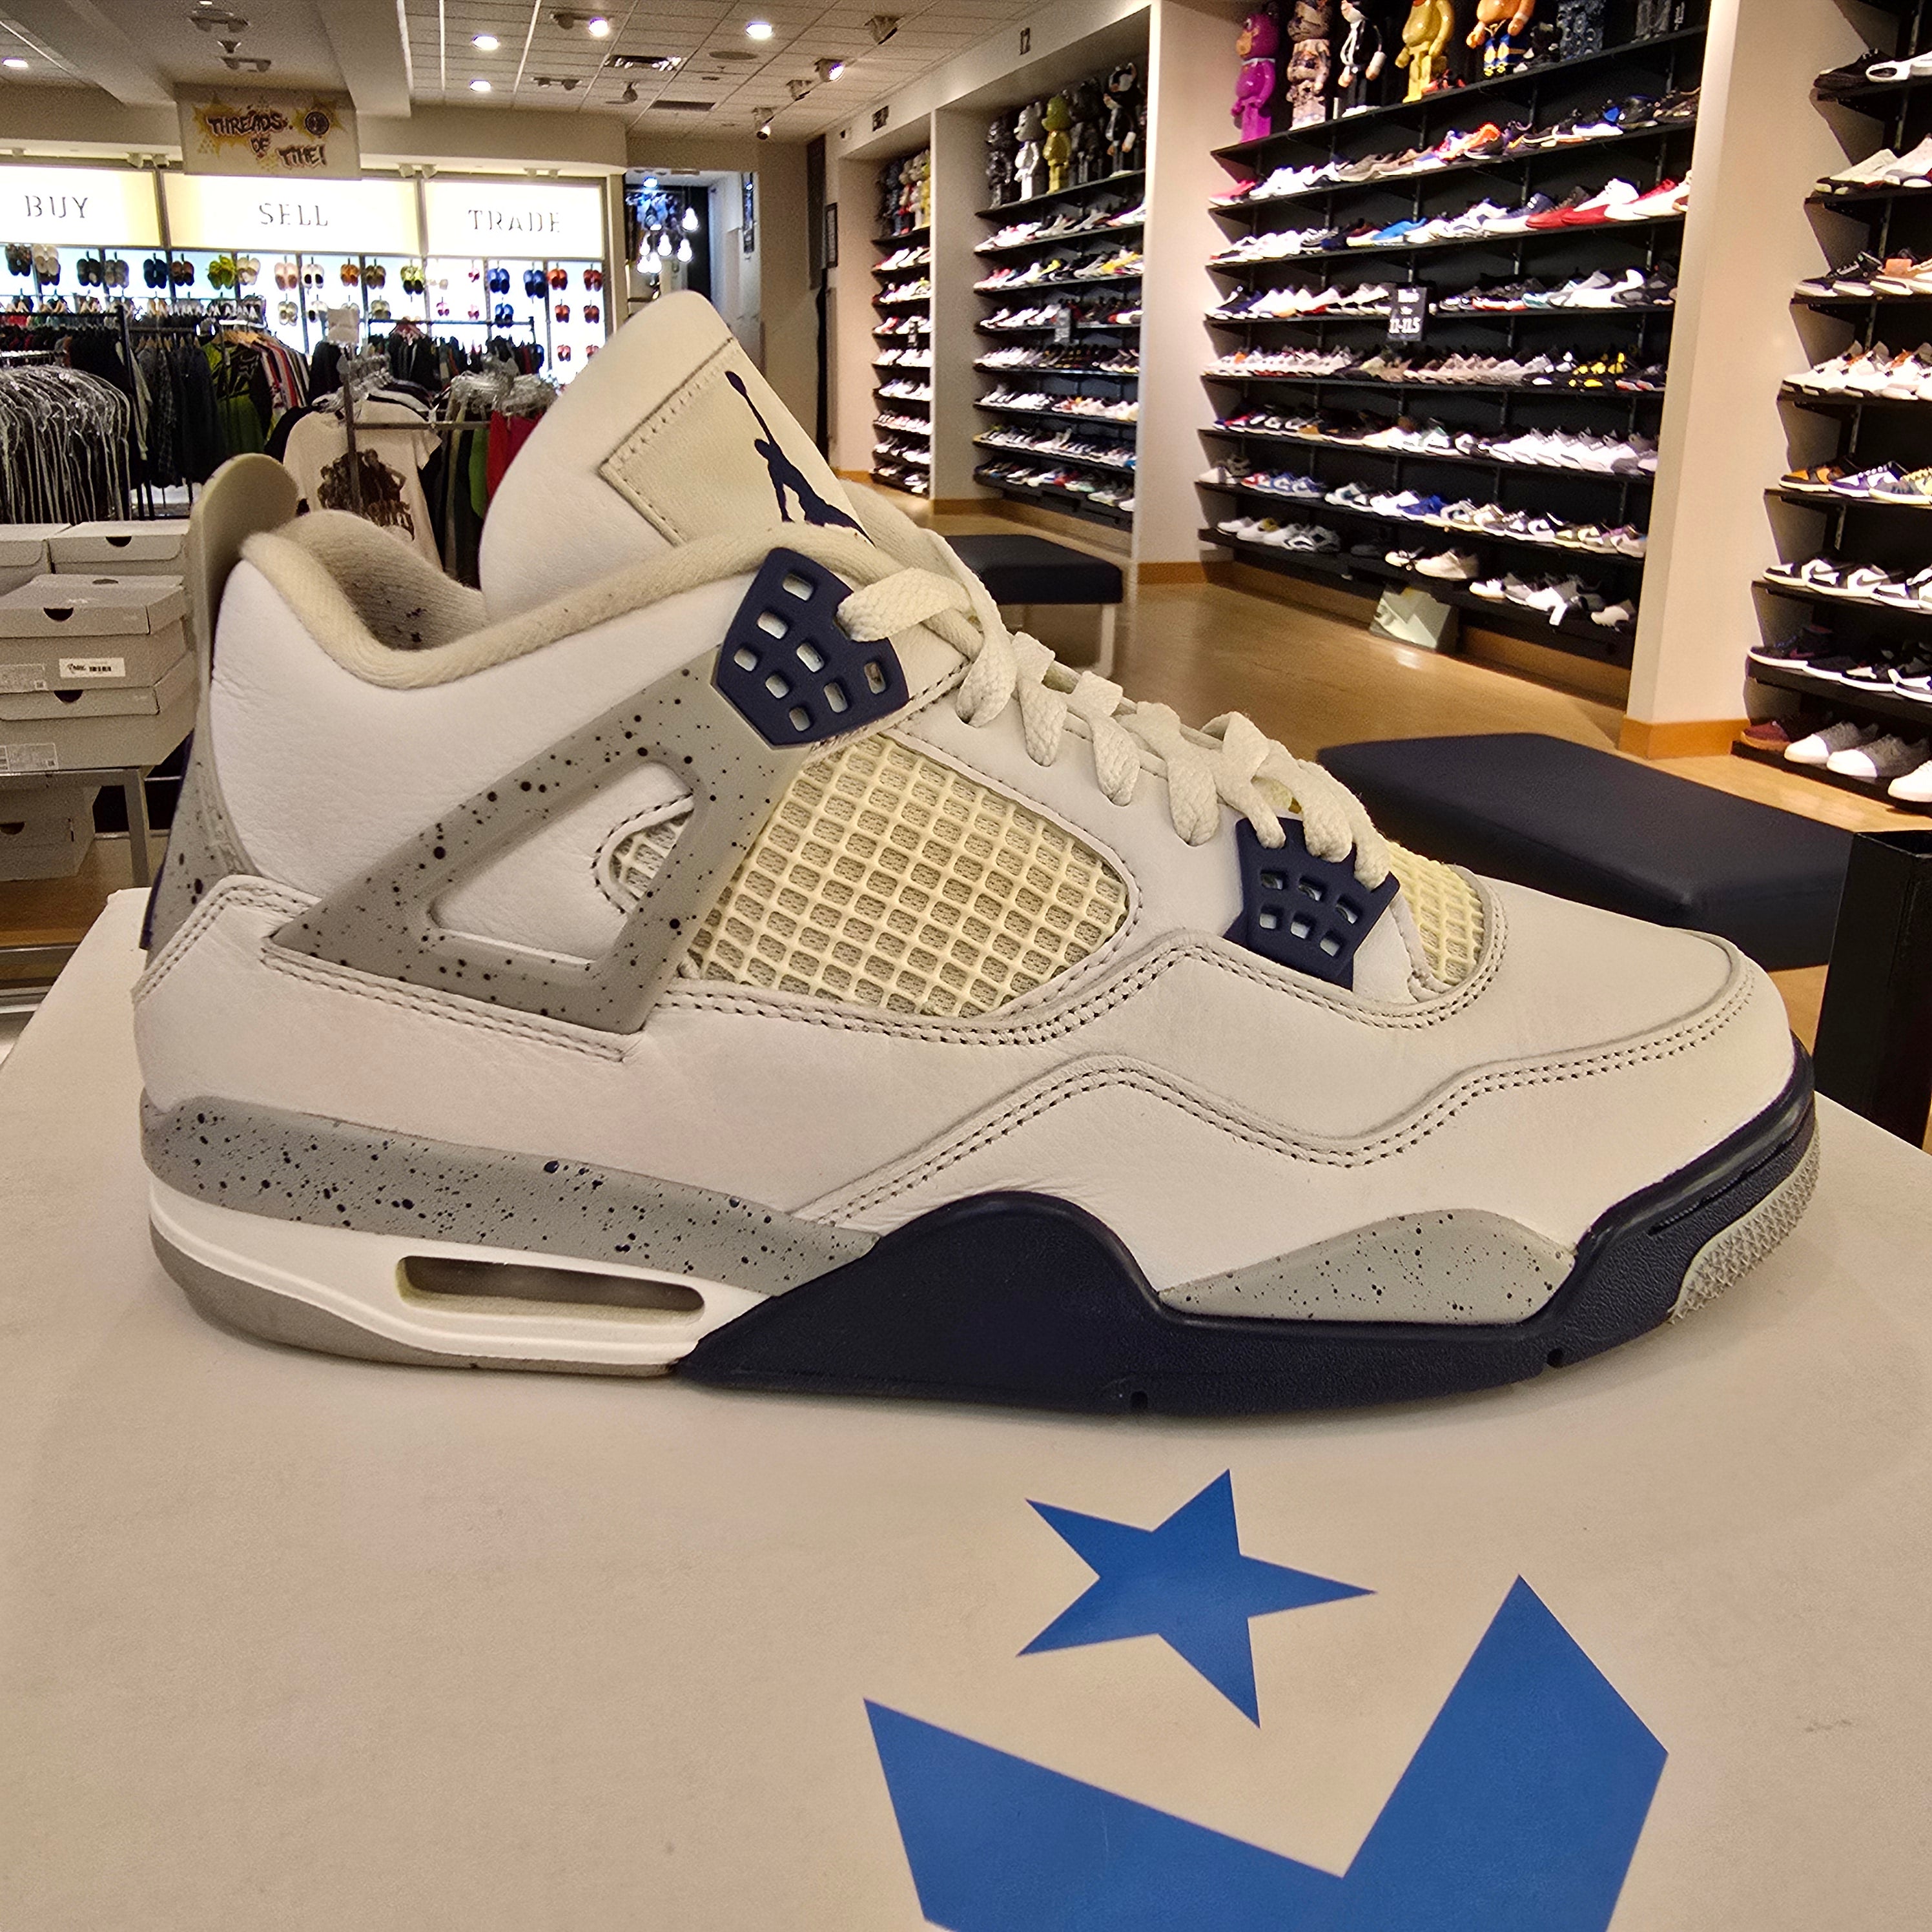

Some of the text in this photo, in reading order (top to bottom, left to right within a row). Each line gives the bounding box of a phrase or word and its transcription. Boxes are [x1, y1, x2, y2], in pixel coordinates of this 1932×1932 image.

[207, 110, 285, 136] THREADS
[25, 195, 88, 218] BUY
[259, 203, 328, 226] SELL
[468, 210, 560, 232] TRADE
